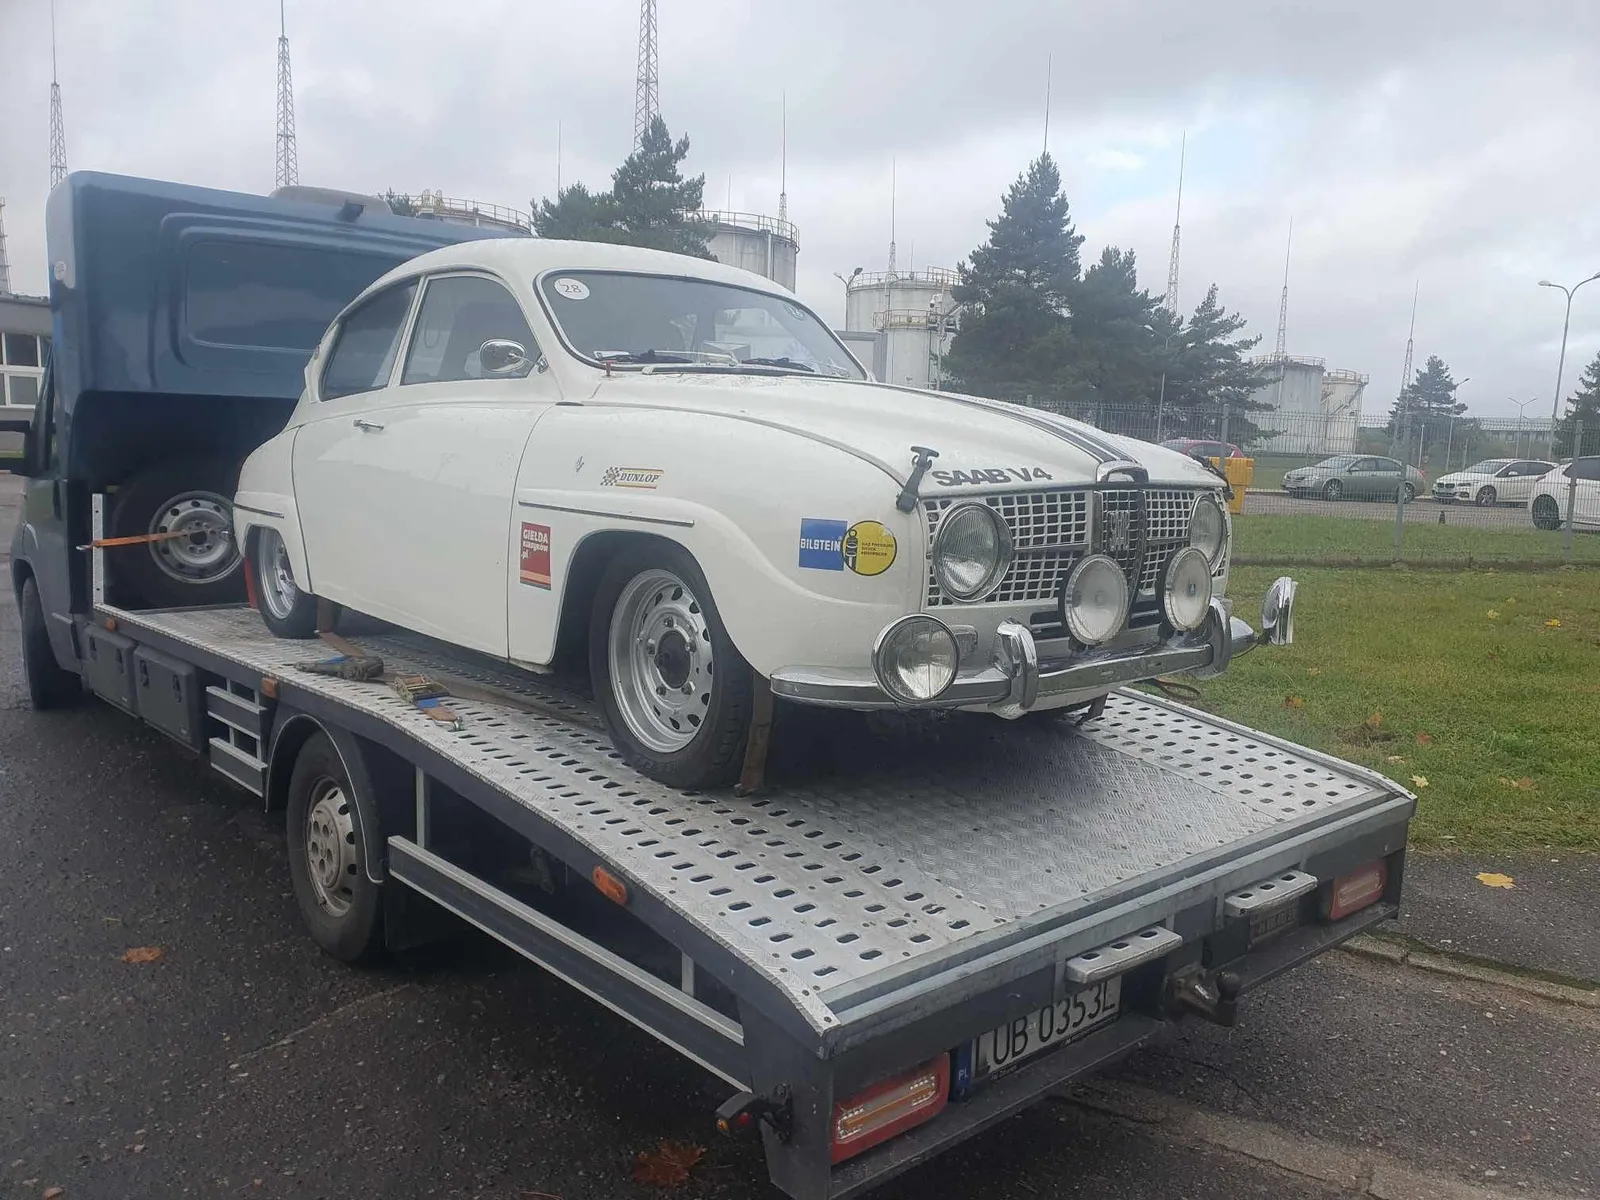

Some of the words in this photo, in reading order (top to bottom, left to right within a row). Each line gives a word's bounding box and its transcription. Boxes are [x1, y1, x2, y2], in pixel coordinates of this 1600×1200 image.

[560, 283, 582, 293] 28
[619, 473, 659, 483] DUNLOP
[932, 468, 1011, 486] SAAB
[1005, 467, 1053, 482] V4
[800, 538, 841, 552] BILSTEIN
[958, 1068, 969, 1081] PL
